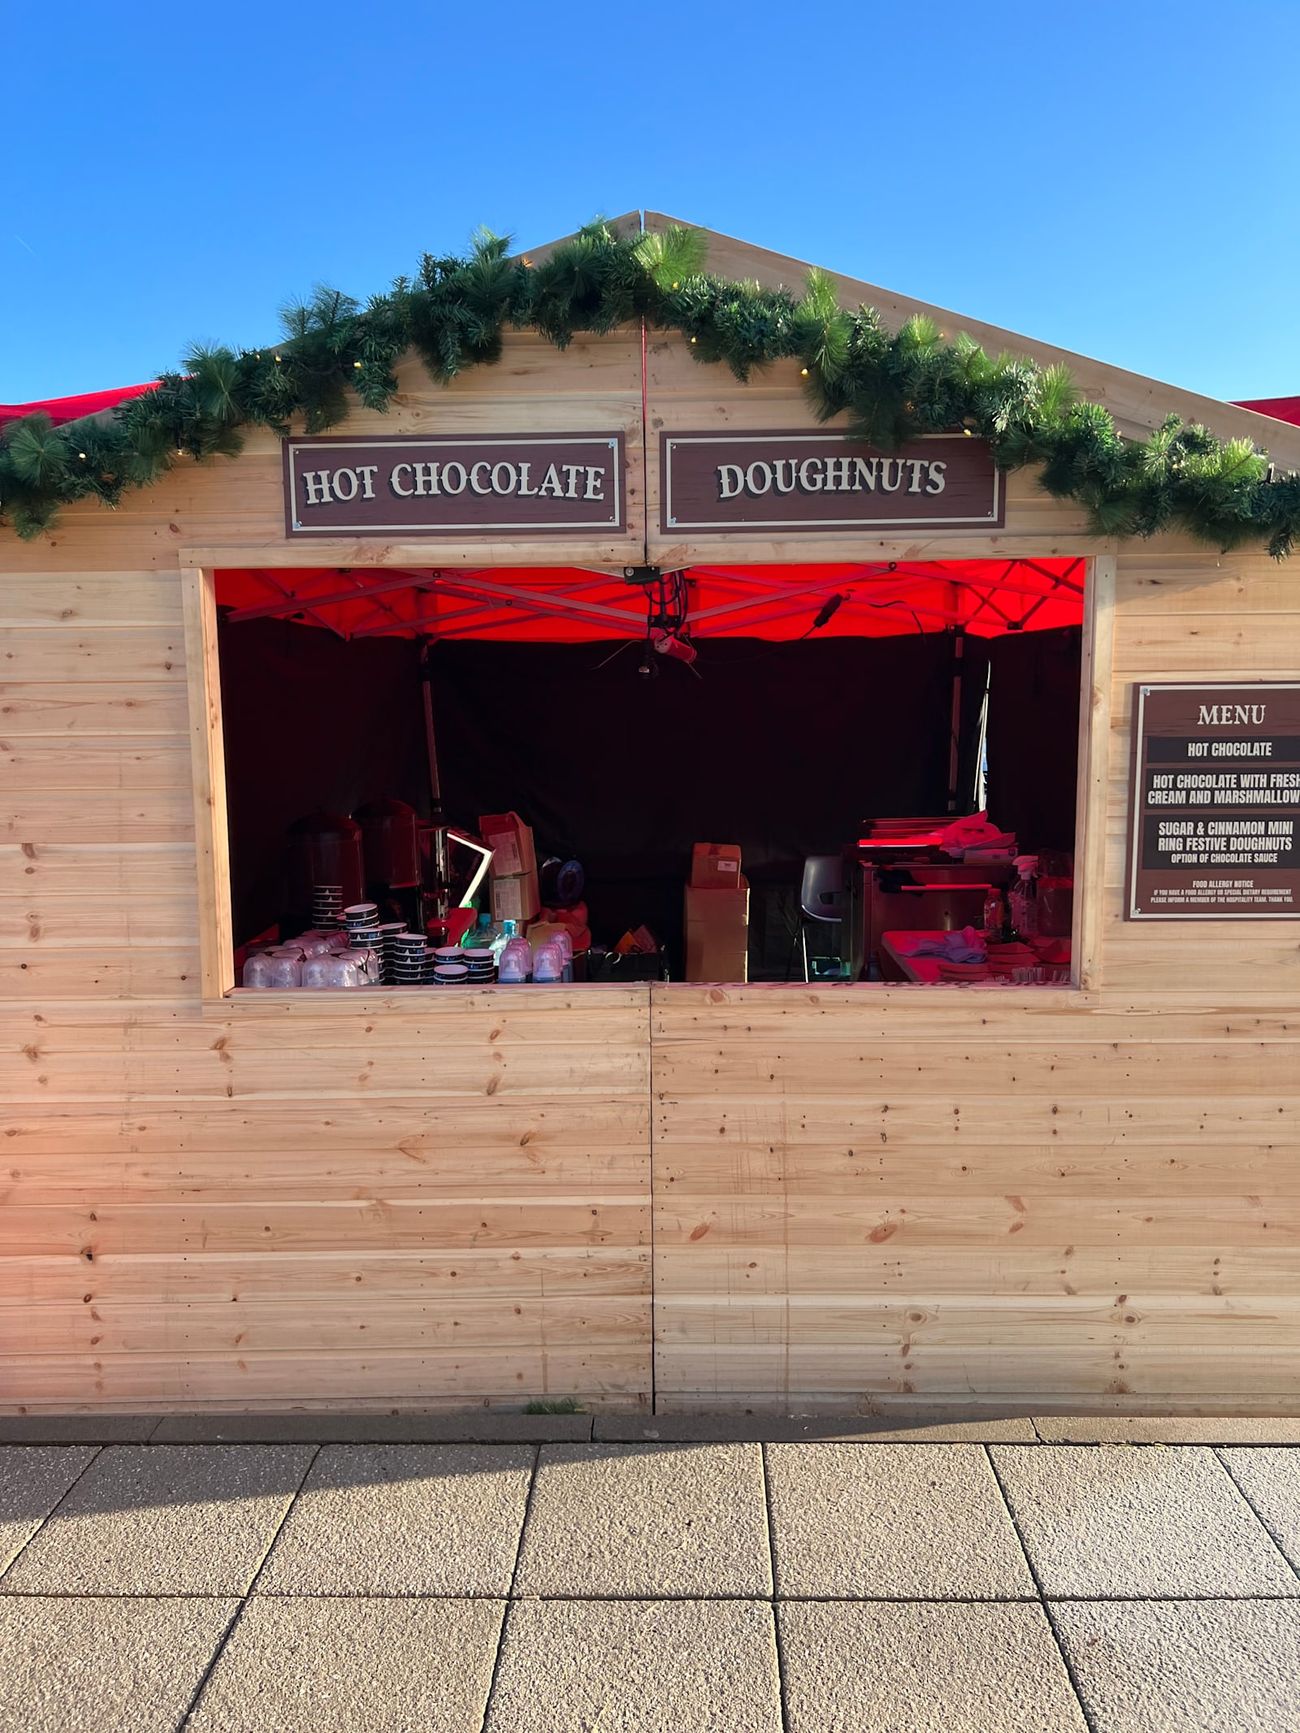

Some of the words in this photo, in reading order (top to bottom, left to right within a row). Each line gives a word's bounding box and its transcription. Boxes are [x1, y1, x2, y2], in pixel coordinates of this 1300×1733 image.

[303, 465, 378, 504] HOT
[390, 461, 606, 500] CHOCOLATE
[717, 457, 948, 498] DOUGHNUTS
[1197, 705, 1266, 725] MENU
[1188, 742, 1209, 757] HOT
[1211, 742, 1272, 757] CHOCOLATE
[1153, 775, 1174, 788] HOT
[1177, 775, 1237, 788] CHOCOLATE
[1240, 774, 1267, 788] WITH
[1148, 790, 1186, 804] CREAM
[1189, 790, 1211, 804] AND
[1158, 821, 1194, 835] SUGAR
[1197, 821, 1205, 835] &
[1207, 821, 1265, 835] CINNAMON
[1268, 821, 1294, 835] MINI
[1158, 837, 1183, 851] RING
[1186, 837, 1227, 851] FESTIVE
[1230, 837, 1293, 851] DOUGHNUTS
[1171, 853, 1197, 863] OPTION
[1200, 853, 1209, 863] OF
[1211, 853, 1252, 863] CHOCOLATE
[1254, 853, 1278, 863] SAUCE
[1192, 880, 1208, 888] FOOD
[1209, 880, 1233, 888] ALLERGY
[1234, 880, 1254, 888] NOTICE
